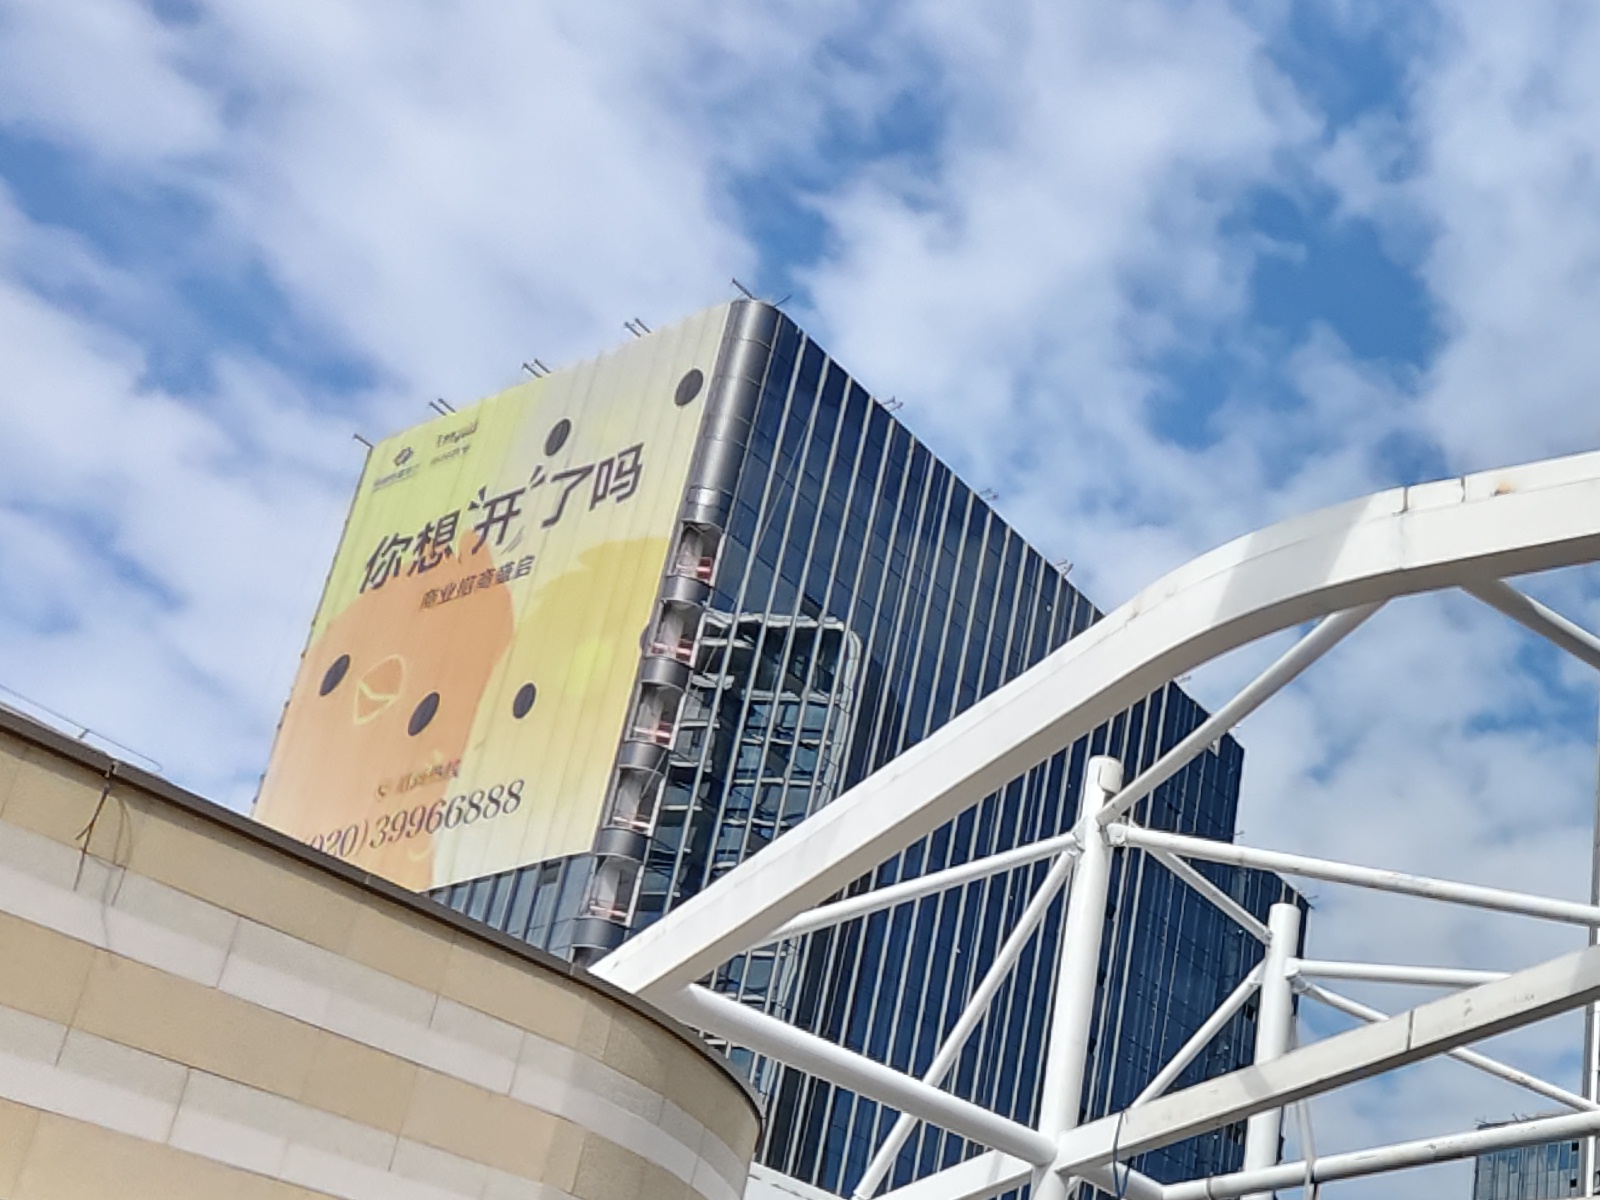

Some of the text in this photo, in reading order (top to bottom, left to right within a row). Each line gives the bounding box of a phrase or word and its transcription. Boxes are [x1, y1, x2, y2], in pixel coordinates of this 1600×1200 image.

[360, 442, 645, 594] 你想开了吗
